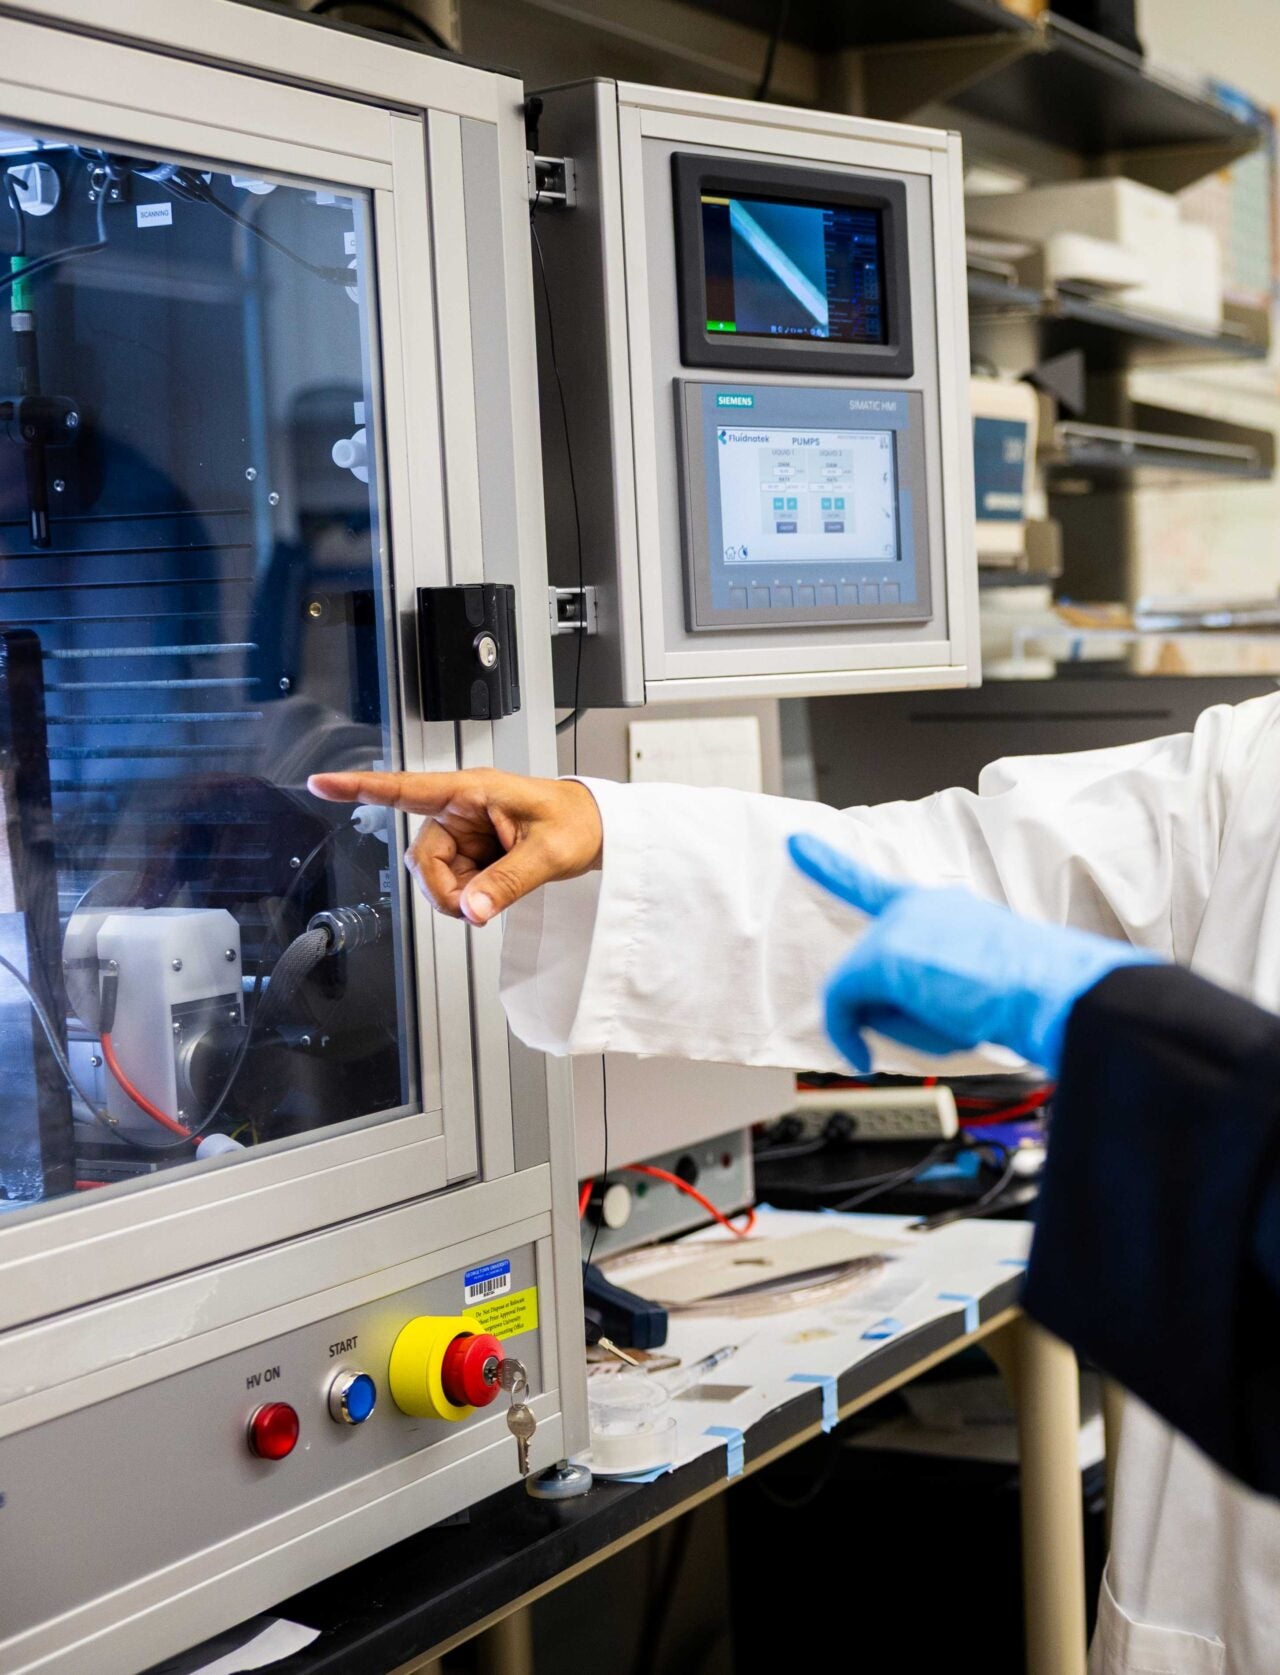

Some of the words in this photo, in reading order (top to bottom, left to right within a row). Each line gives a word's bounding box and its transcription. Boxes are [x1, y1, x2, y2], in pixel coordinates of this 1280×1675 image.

[140, 209, 169, 219] SCANNING
[718, 396, 752, 406] SIEMENS
[849, 399, 880, 411] SIMATIC
[881, 400, 897, 411] HMI
[728, 431, 770, 443] Fluidnatek
[791, 436, 820, 446] PUMPS
[329, 1335, 359, 1358] START
[246, 1372, 262, 1390] HV
[263, 1365, 281, 1383] ON
